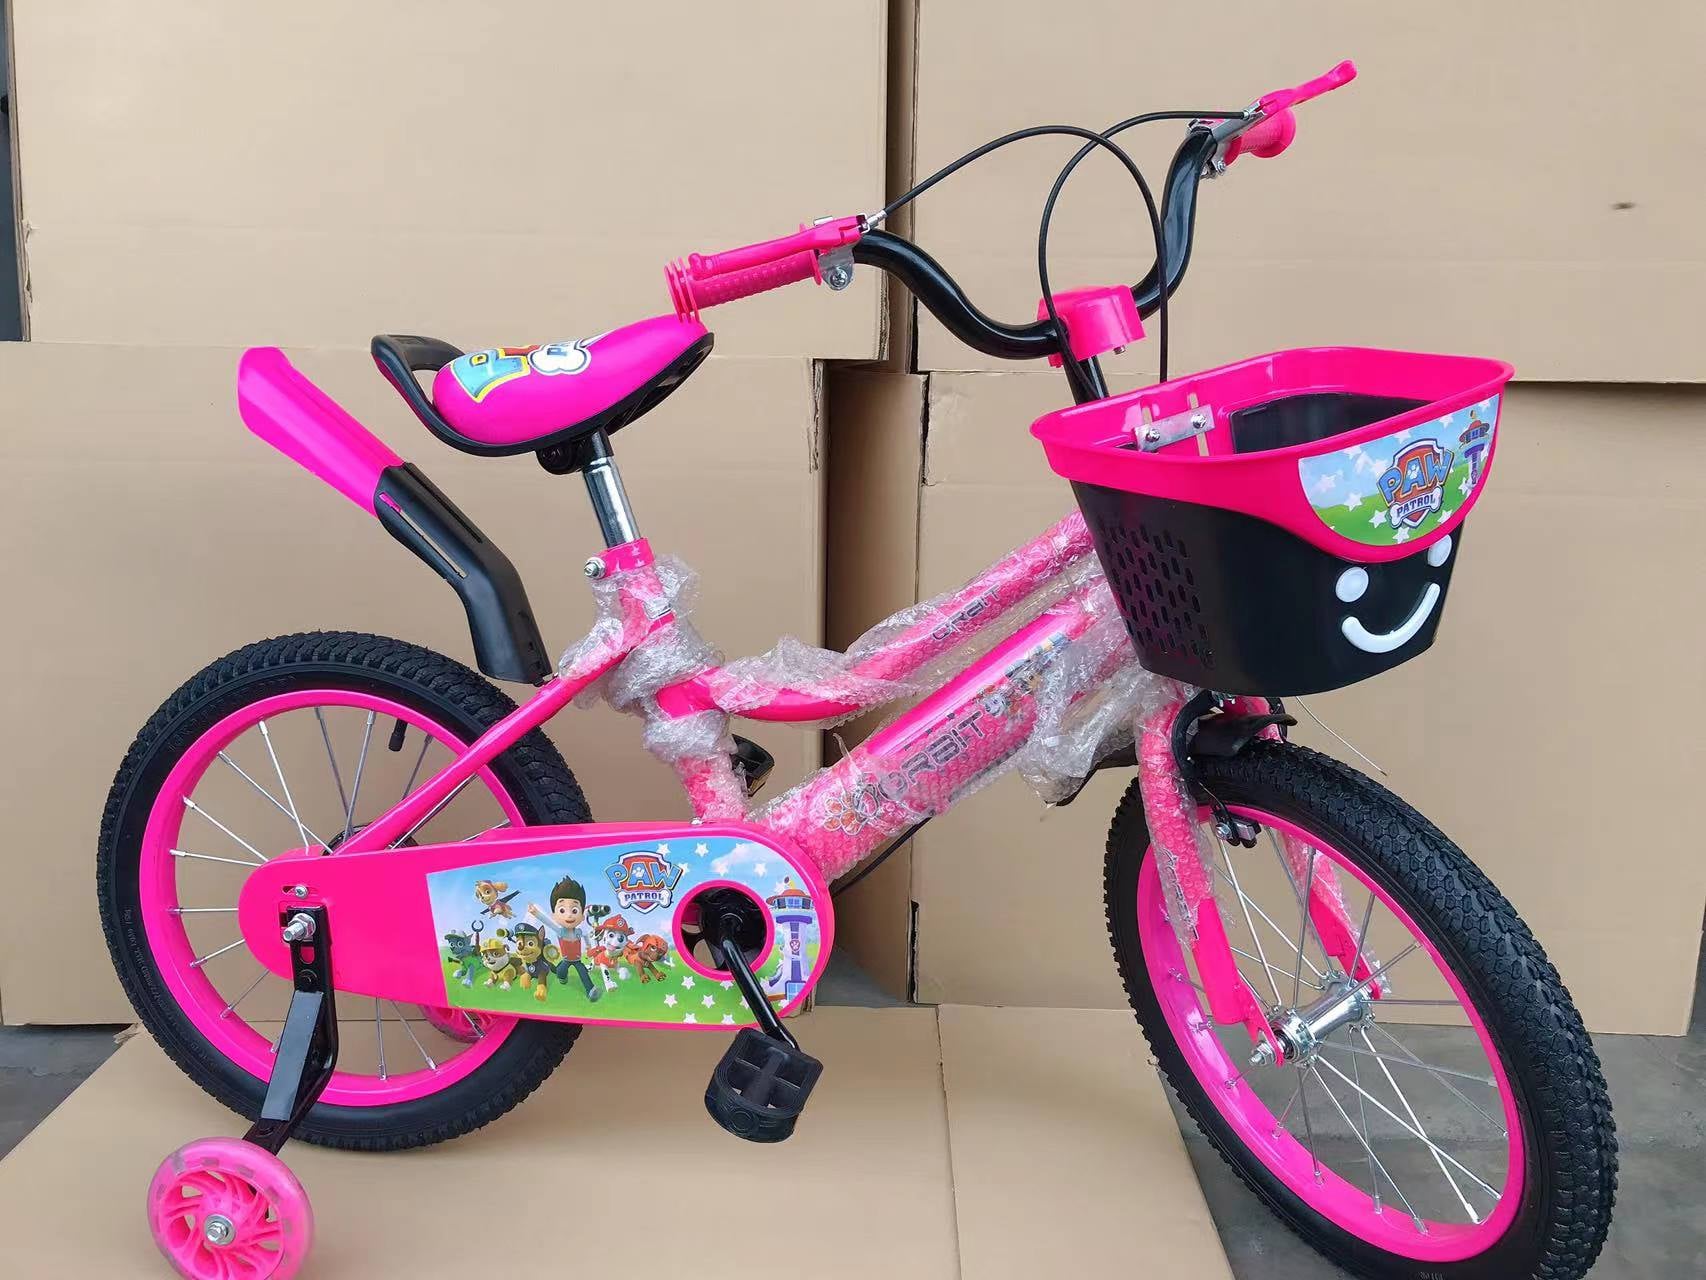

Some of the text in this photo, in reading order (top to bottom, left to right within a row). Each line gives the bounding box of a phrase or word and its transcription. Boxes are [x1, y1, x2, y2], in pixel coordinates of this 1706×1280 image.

[1377, 450, 1454, 504] PAW
[1396, 494, 1436, 517] PATROL
[605, 862, 683, 891] PAW
[624, 891, 664, 901] PATROL
